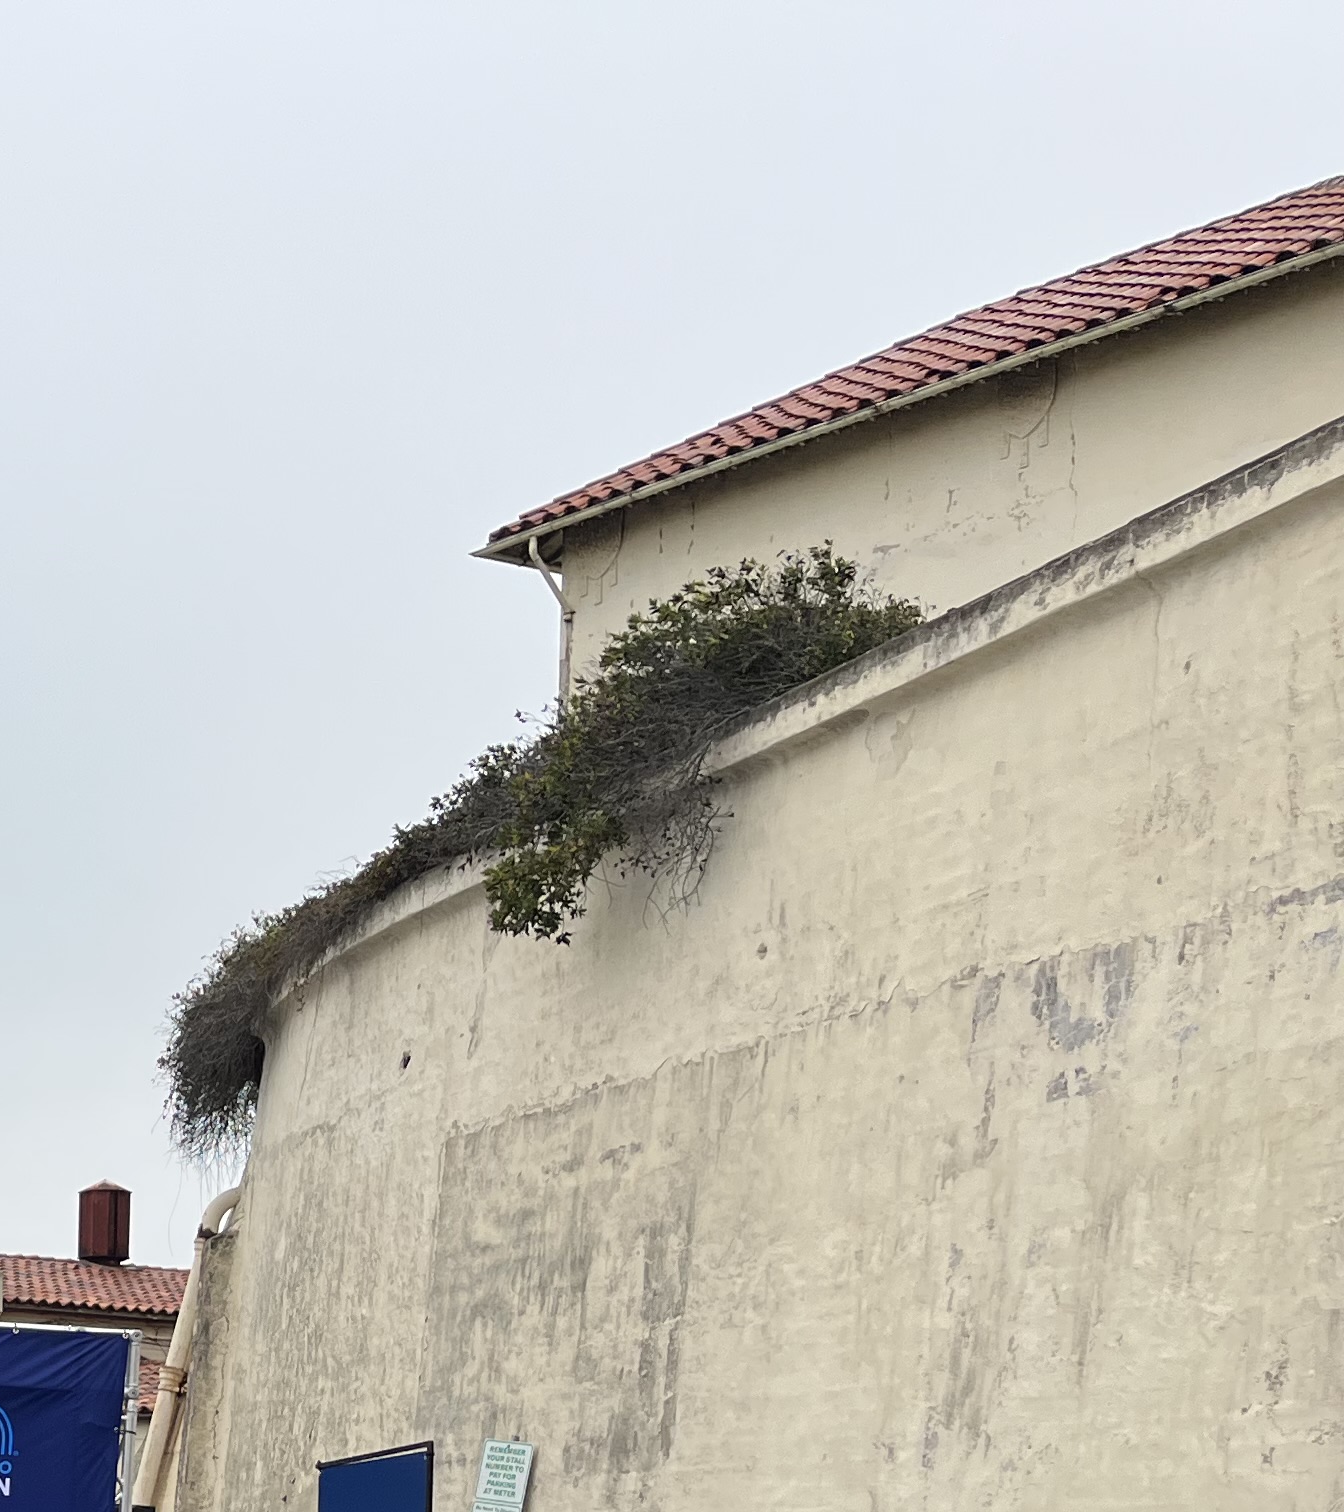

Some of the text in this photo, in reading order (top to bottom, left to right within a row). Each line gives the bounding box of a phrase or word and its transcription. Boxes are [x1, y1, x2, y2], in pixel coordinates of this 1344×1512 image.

[487, 1454, 505, 1463] YOUR
[489, 1471, 517, 1480] PAY FOR
